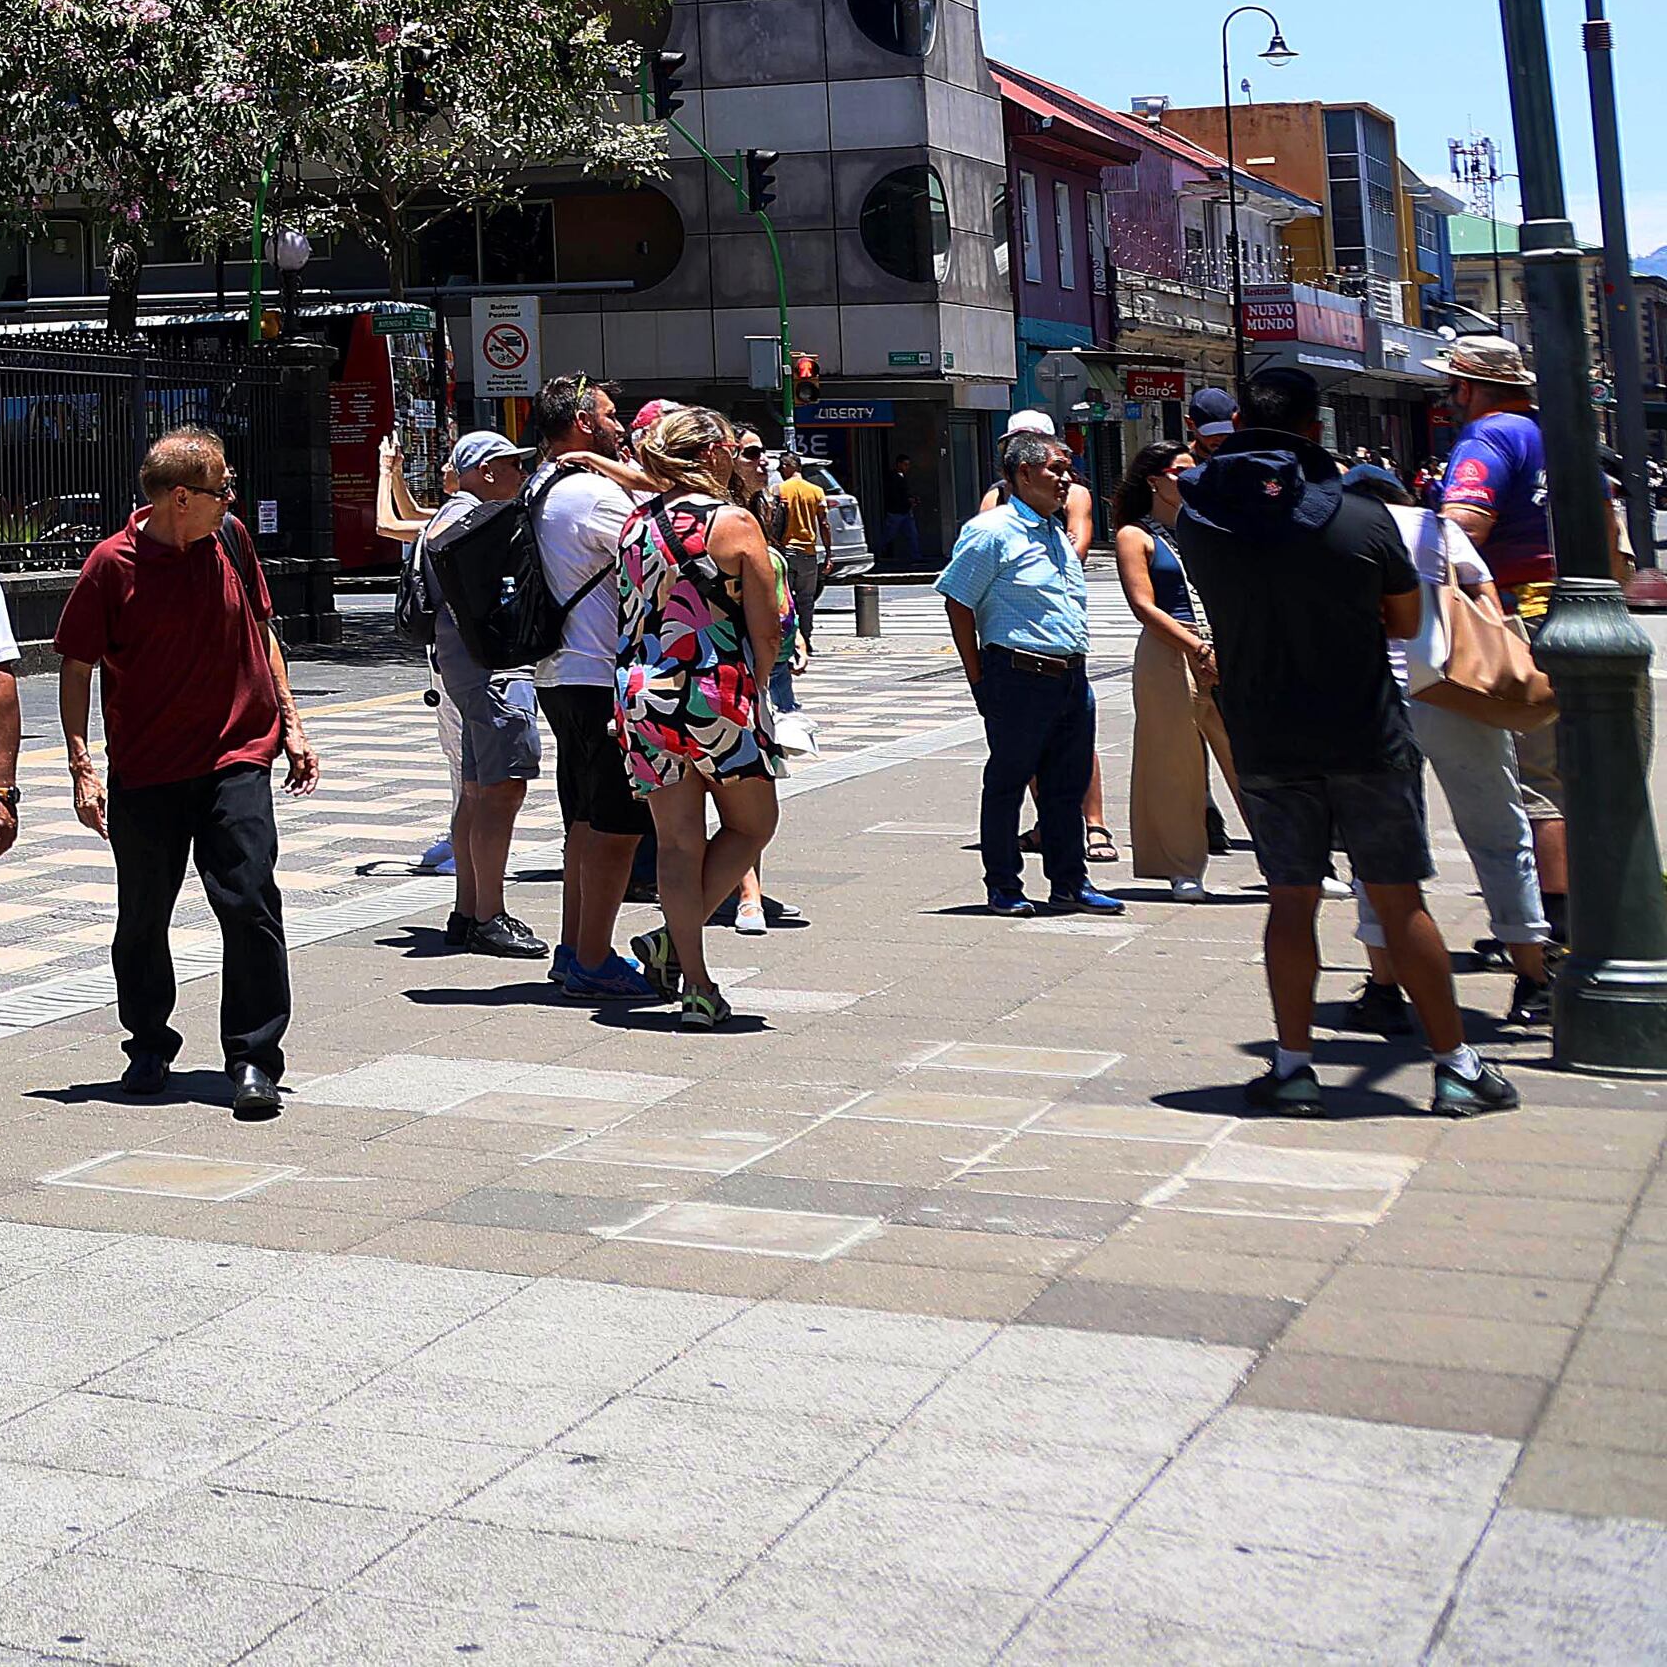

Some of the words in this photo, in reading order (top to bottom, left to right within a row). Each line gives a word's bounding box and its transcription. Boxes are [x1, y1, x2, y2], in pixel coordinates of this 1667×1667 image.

[1248, 303, 1294, 317] NUEVO
[1247, 318, 1295, 331] MUNDO
[1134, 385, 1170, 396] Claro
[818, 407, 875, 419] LIBERTY
